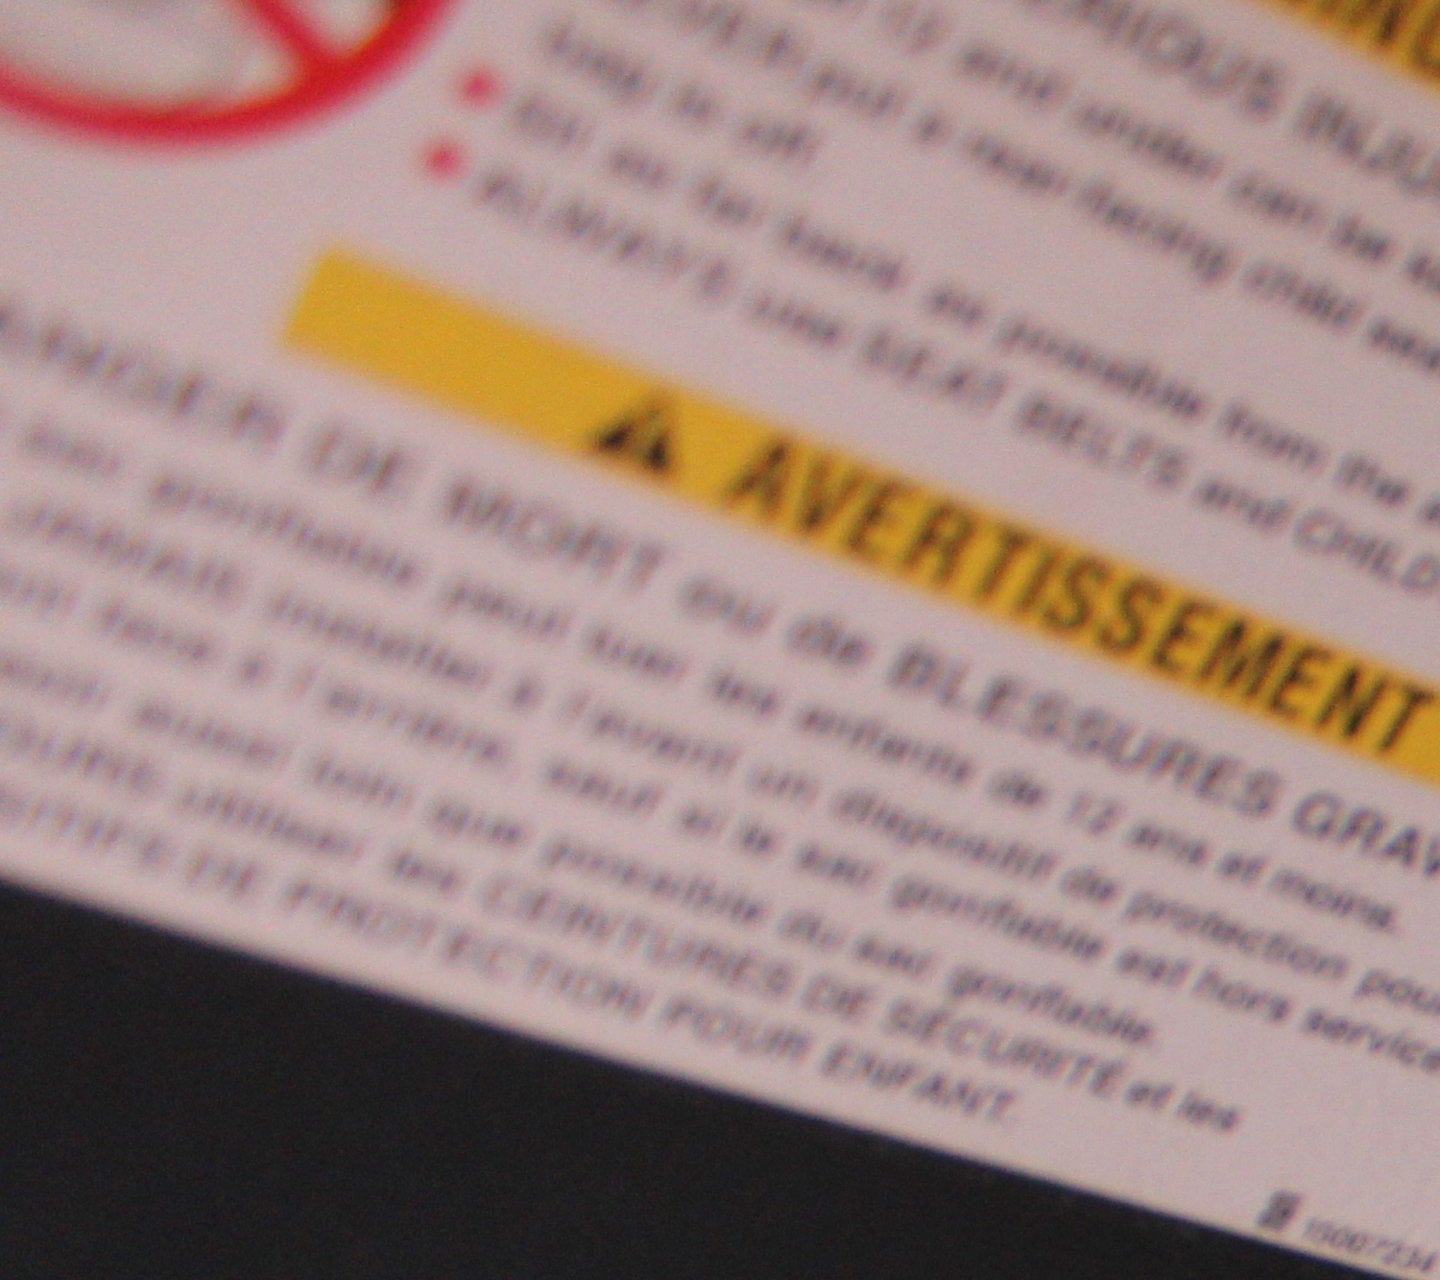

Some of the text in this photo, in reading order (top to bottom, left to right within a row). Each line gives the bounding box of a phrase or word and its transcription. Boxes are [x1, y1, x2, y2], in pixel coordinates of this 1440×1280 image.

[1220, 403, 1325, 470] from
[1338, 457, 1411, 509] the
[444, 479, 662, 582] MORT
[790, 618, 871, 668] de
[892, 647, 1279, 817] BLESSURES
[735, 445, 1431, 749] AVERTISSEMENT
[1062, 868, 1120, 905] de
[1126, 892, 1348, 979] protection
[1068, 792, 1124, 837] 12
[1129, 822, 1210, 867] ans
[1219, 853, 1267, 884] et
[1273, 871, 1406, 935] moins.
[804, 976, 872, 1020] DE
[1125, 1081, 1173, 1110] et
[1178, 1093, 1240, 1132] les
[1117, 949, 1190, 986] est
[1195, 968, 1293, 1024] hors
